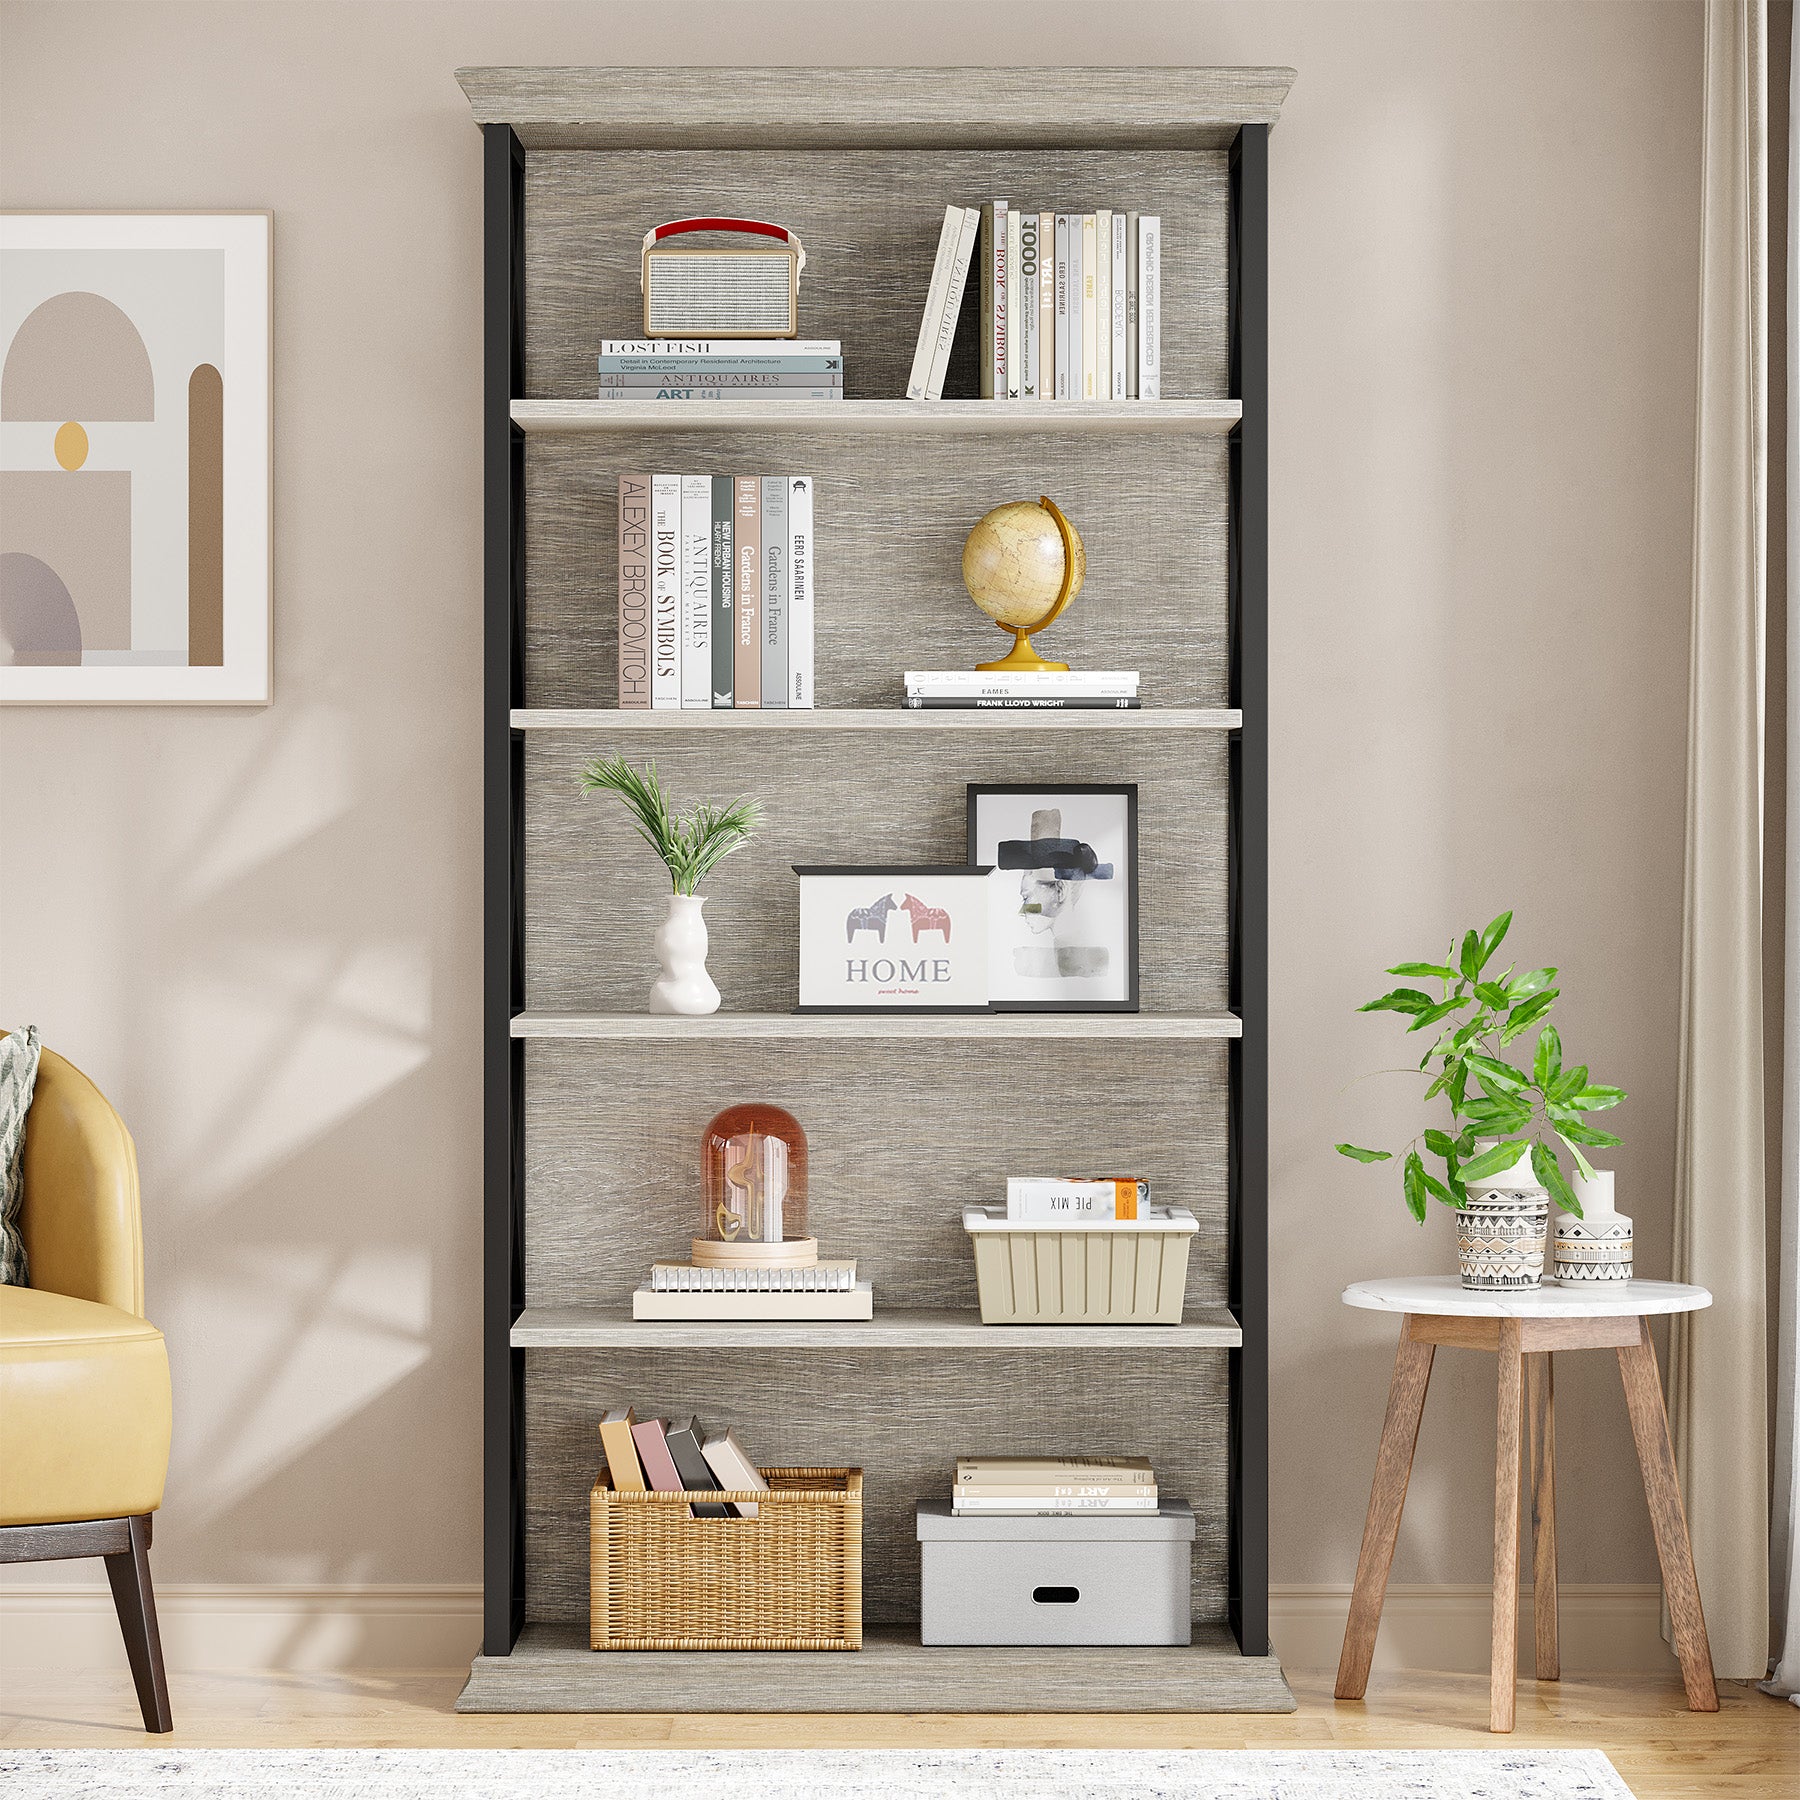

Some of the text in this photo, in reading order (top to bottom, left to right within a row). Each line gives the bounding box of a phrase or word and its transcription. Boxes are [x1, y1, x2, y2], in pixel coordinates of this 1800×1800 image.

[609, 343, 711, 353] LOST FISH
[655, 389, 694, 400] ART
[661, 374, 780, 383] ANTIQUAIRES
[714, 521, 722, 568] HILARY FRENCH
[721, 521, 731, 608] NEW URBAN HOUSING
[794, 535, 805, 601] EERO SAARINEN
[622, 480, 647, 694] ALEXEY BRODOVITCH
[656, 510, 676, 677] THE BOOK OF SYMBOLS
[689, 534, 708, 649] ANTIQUAIRES
[741, 546, 755, 646] Gardens in France
[768, 546, 782, 645] Gardens in France
[846, 959, 952, 983] HOME
[1050, 1196, 1092, 1210] PIE MIX
[1077, 1487, 1110, 1496] ART
[1077, 1499, 1109, 1508] ART
